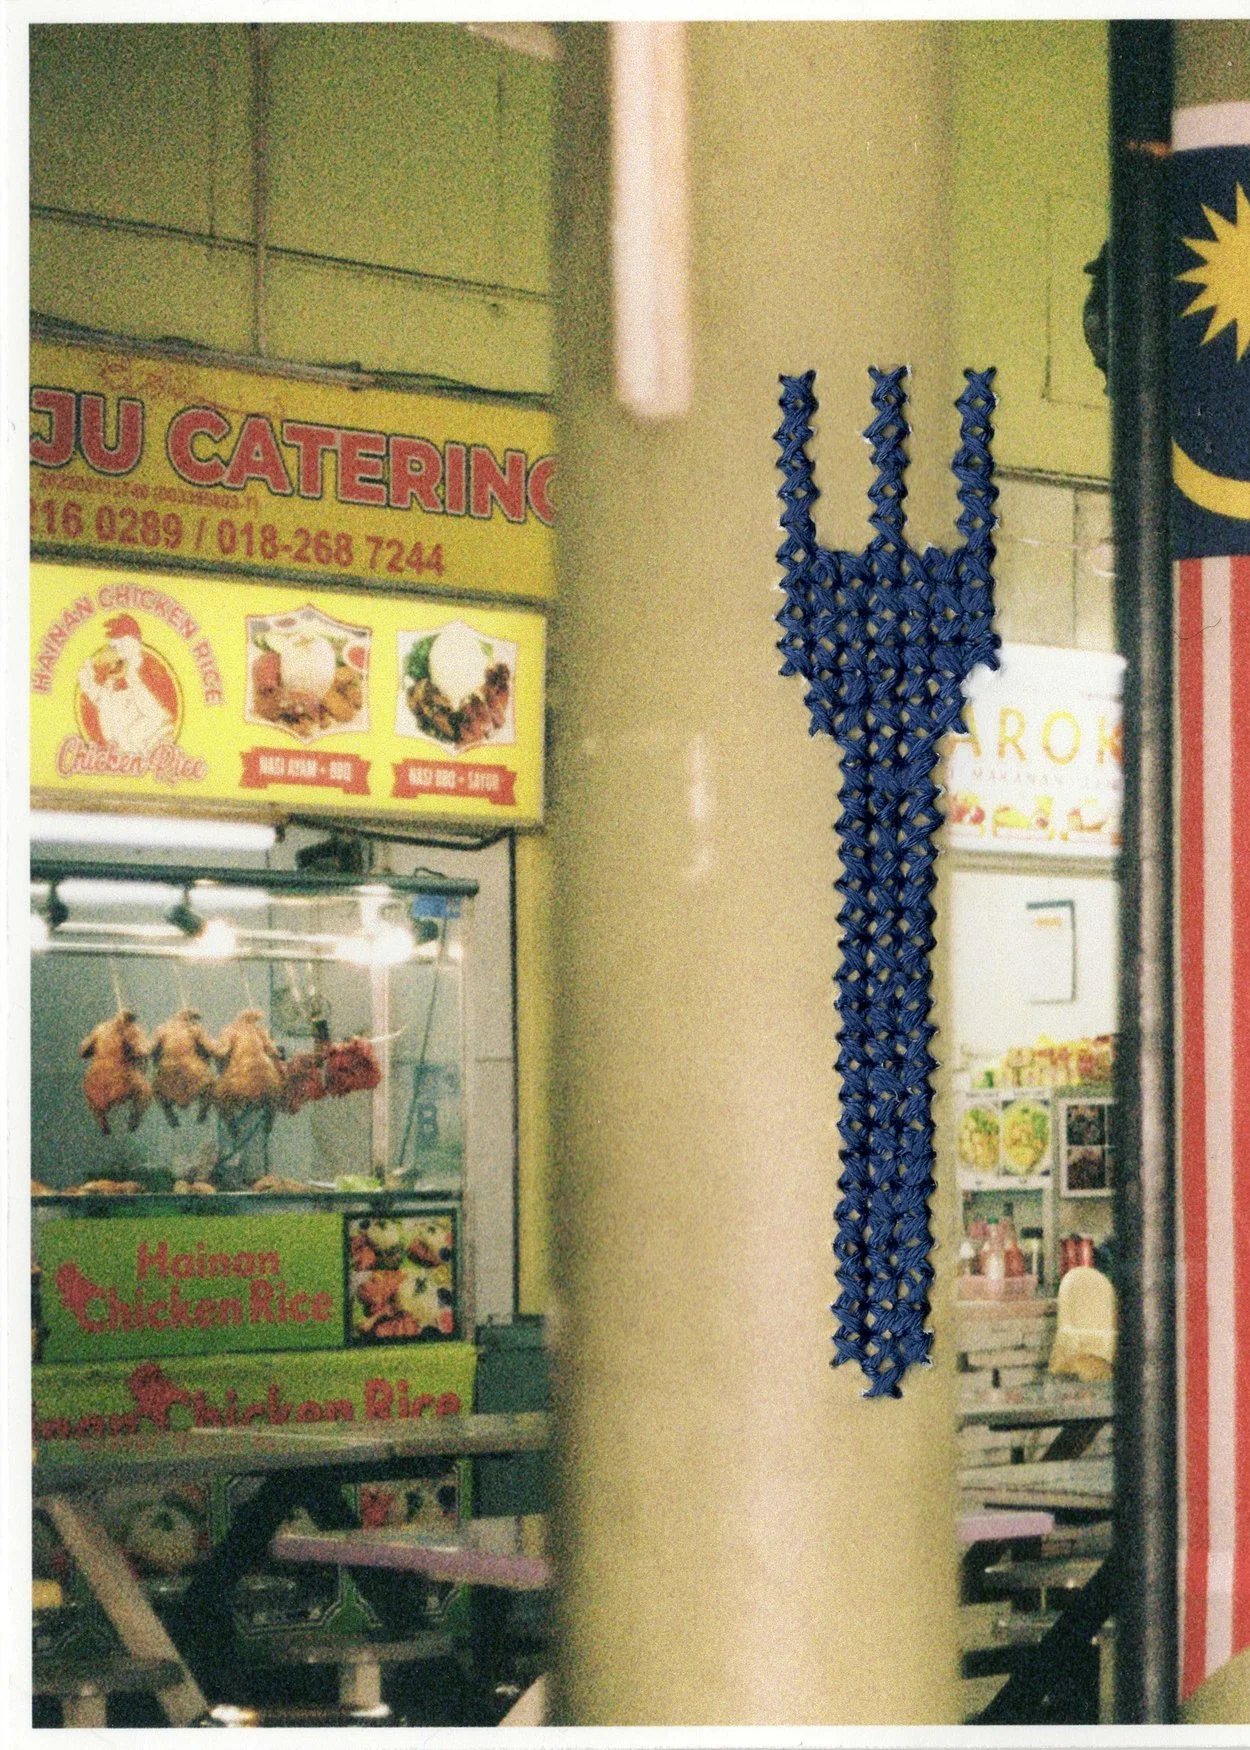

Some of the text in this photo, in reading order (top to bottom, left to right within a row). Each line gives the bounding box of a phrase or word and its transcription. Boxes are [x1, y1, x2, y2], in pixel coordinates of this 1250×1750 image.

[96, 504, 183, 549] 0289
[217, 518, 354, 567] 018-268
[365, 535, 445, 576] 7244
[32, 584, 226, 704] HAINAN CHICKEN RICE
[56, 733, 148, 778] Chicken
[136, 1241, 280, 1281] Hainan
[250, 1279, 333, 1323] Rice
